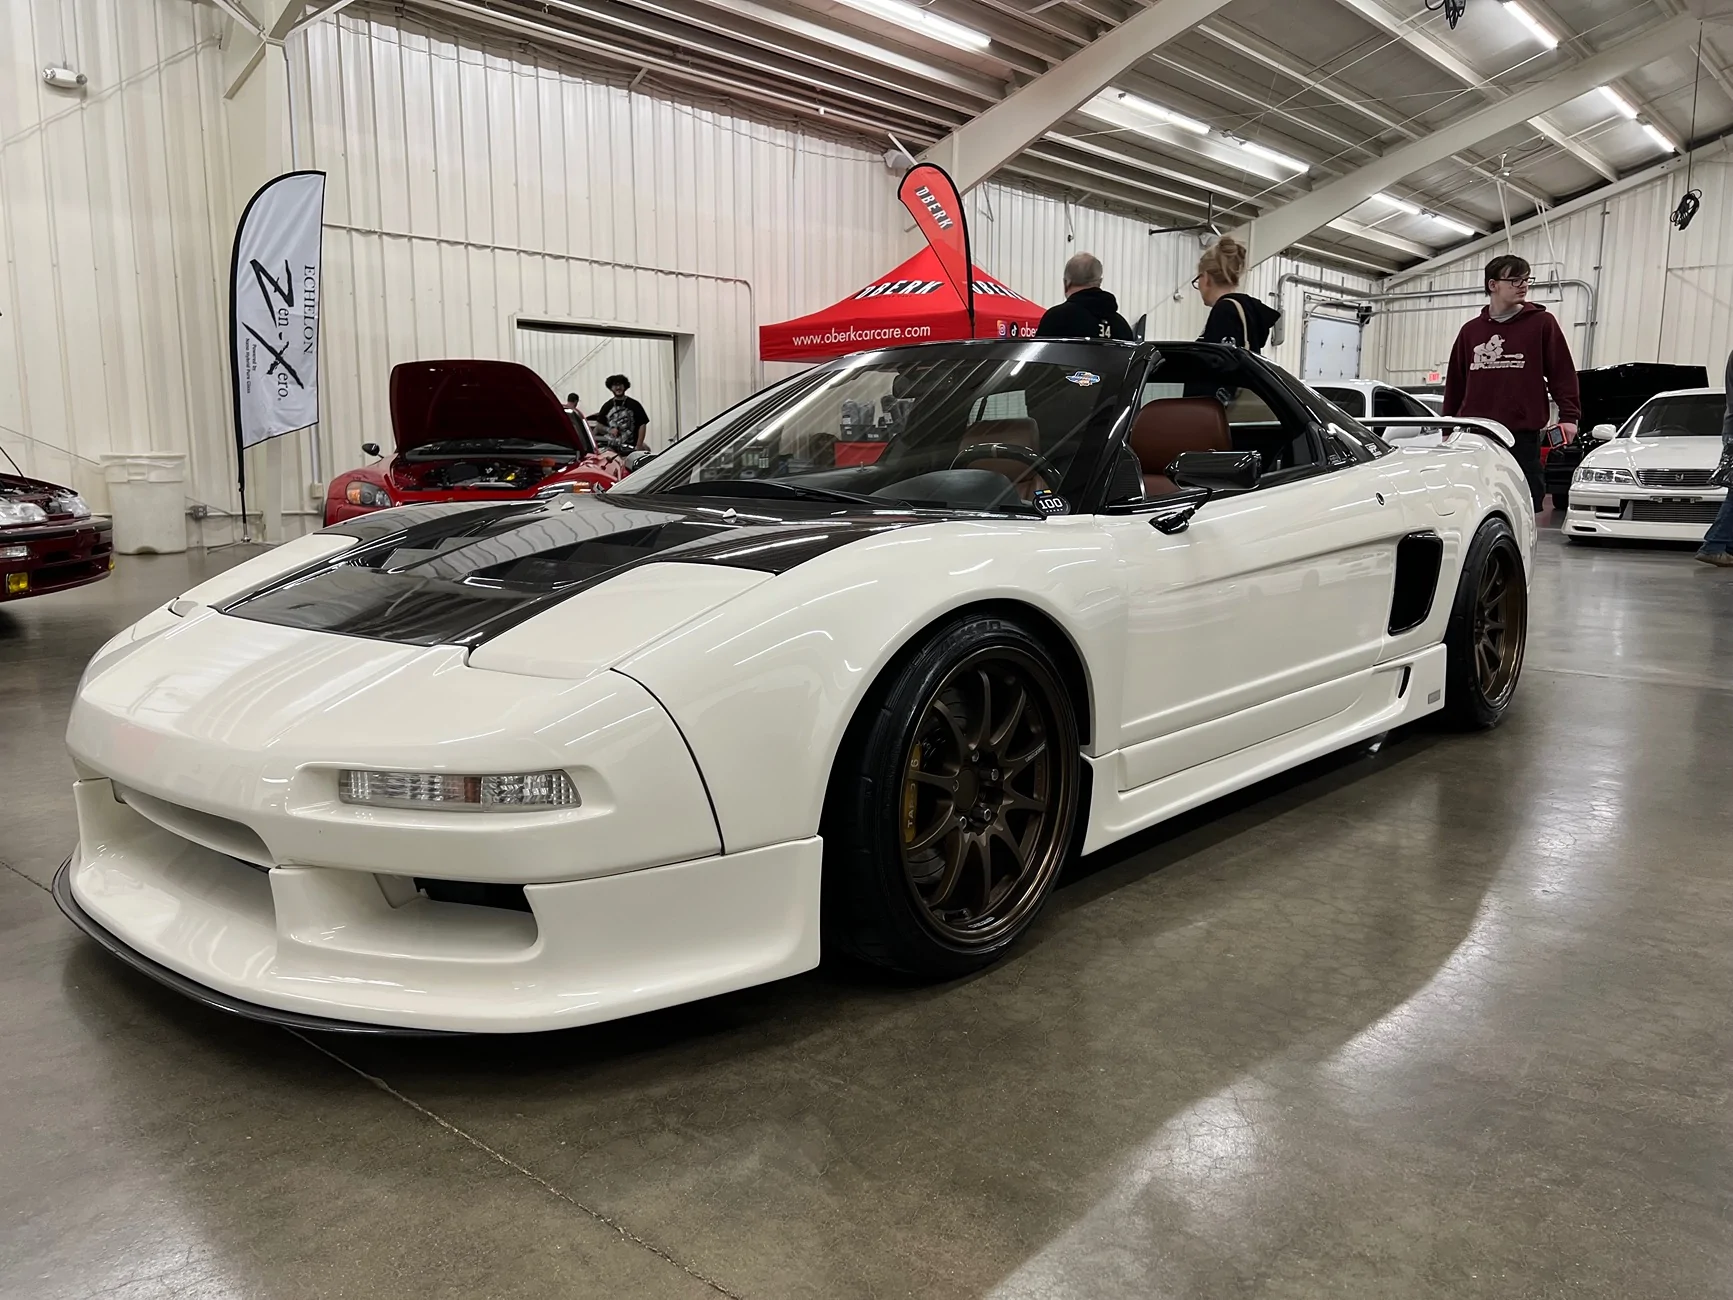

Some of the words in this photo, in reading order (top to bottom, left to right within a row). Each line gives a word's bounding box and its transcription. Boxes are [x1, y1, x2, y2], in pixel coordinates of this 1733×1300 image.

[915, 186, 953, 229] OBERK
[854, 280, 943, 300] OBERK
[303, 265, 316, 354] ECHELON
[792, 325, 931, 346] www.oberkcarcare.com
[1098, 323, 1111, 338] 34
[1038, 498, 1063, 509] 100
